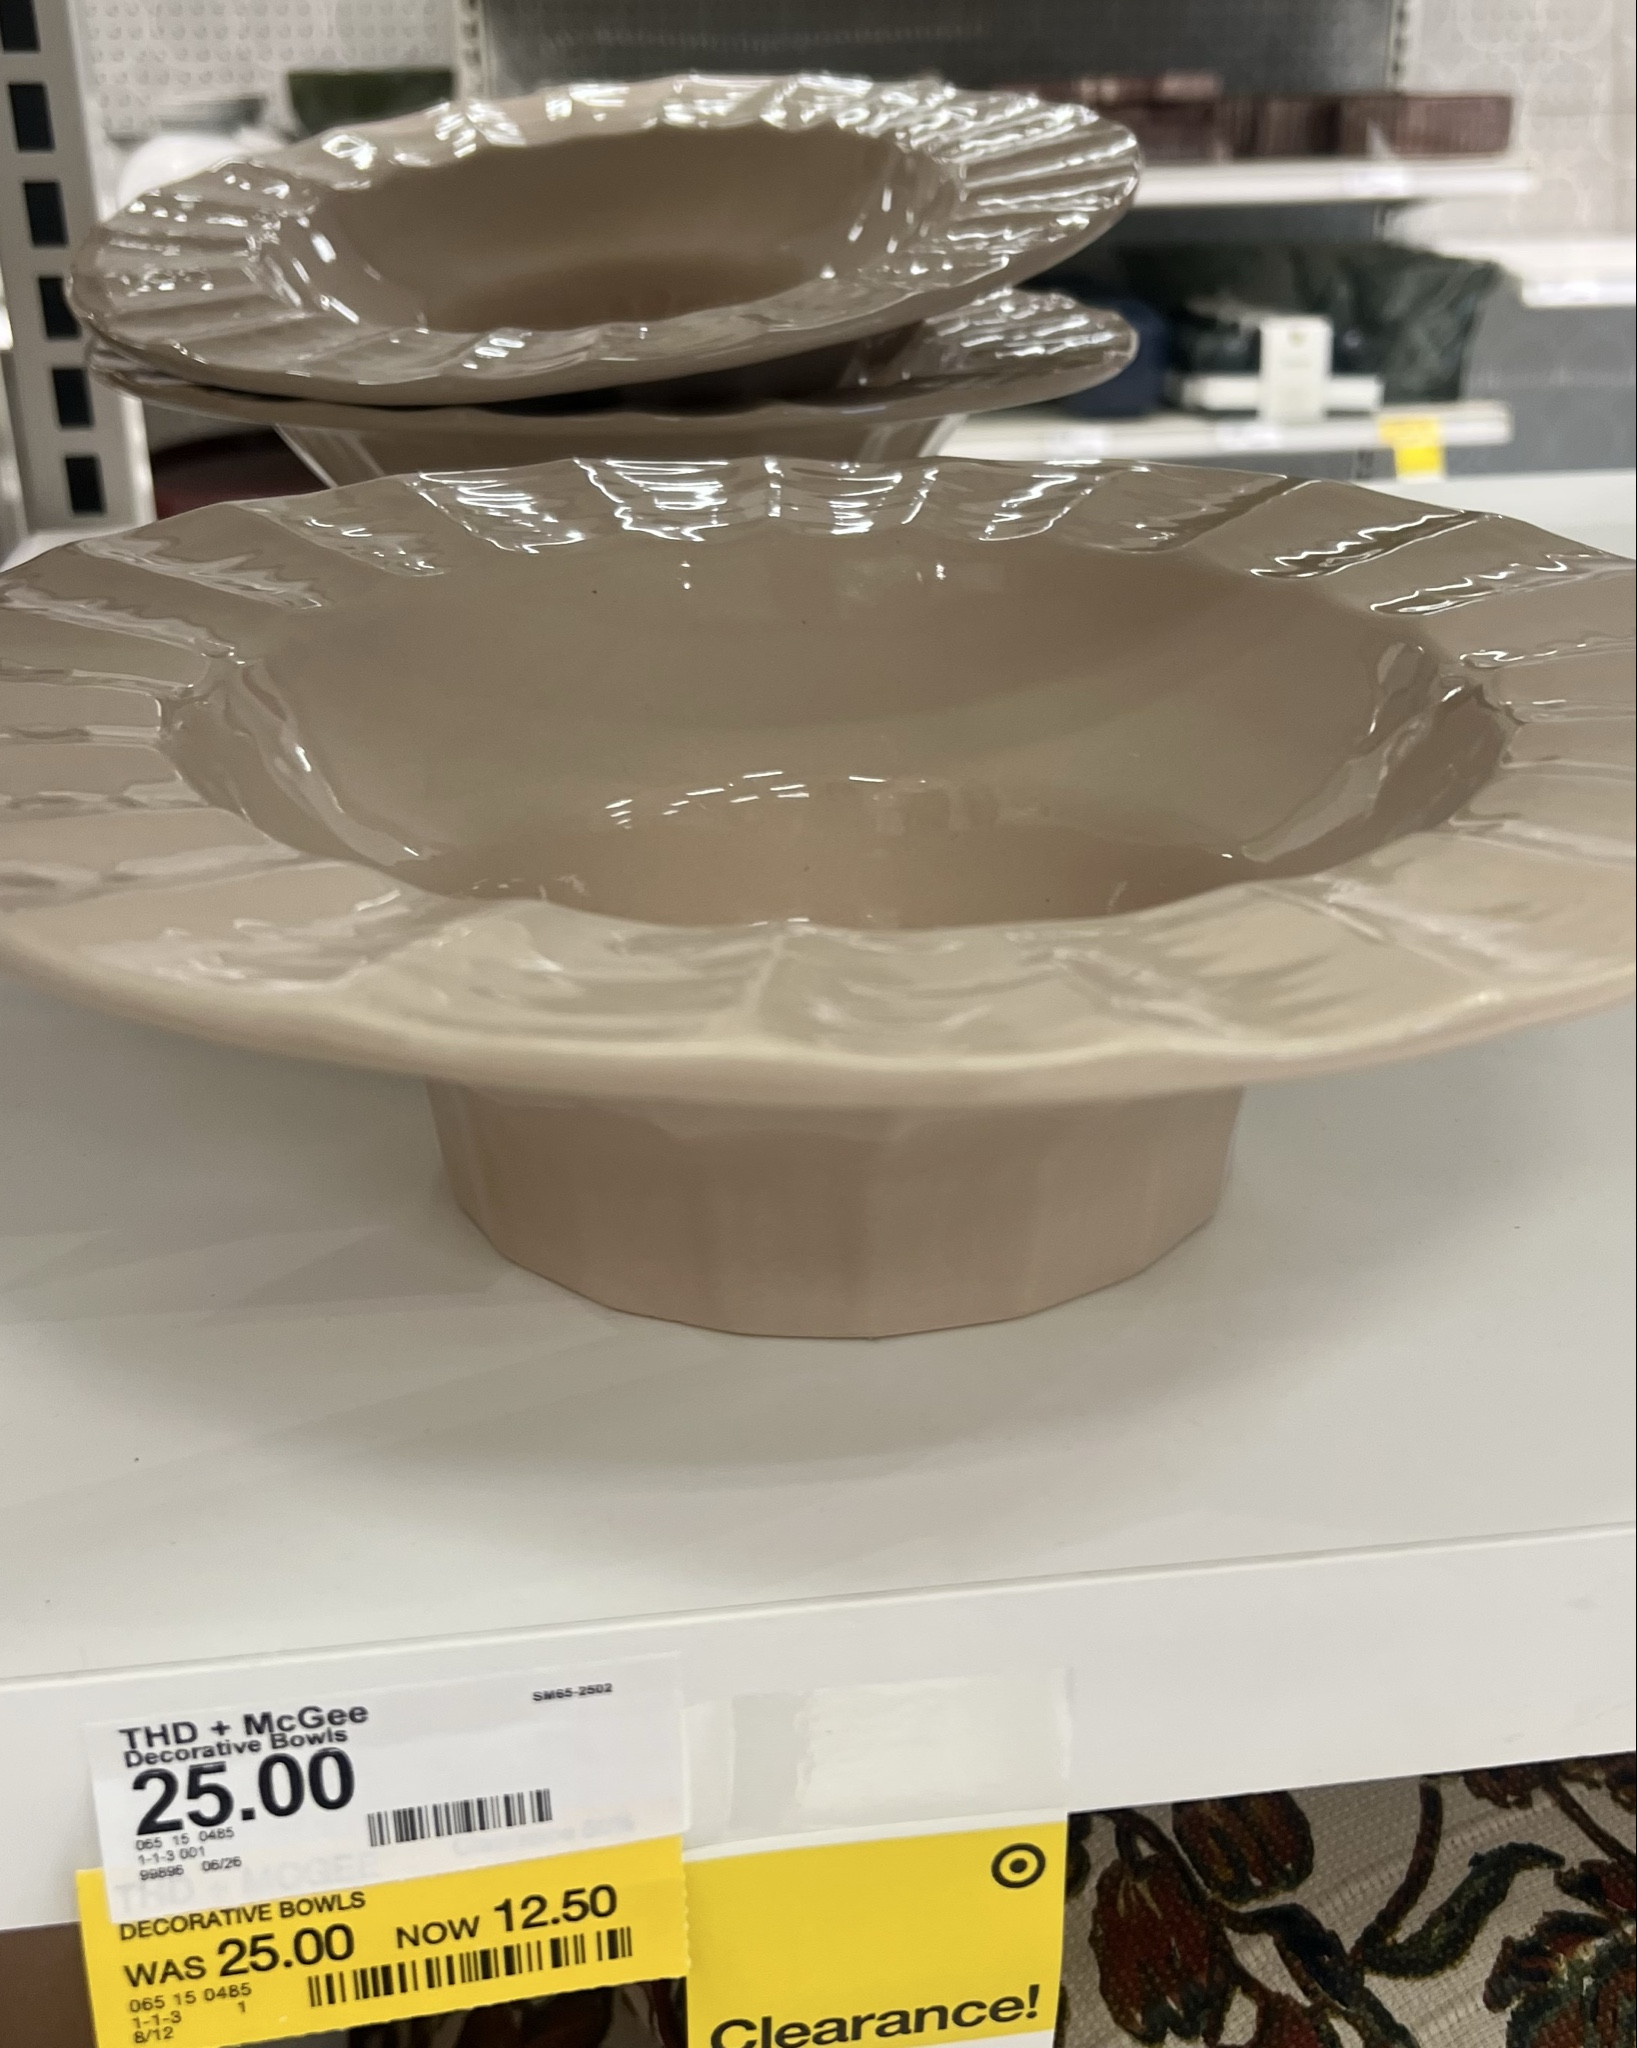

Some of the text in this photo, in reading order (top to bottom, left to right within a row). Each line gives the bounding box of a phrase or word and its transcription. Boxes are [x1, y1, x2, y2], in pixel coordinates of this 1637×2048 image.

[532, 1682, 613, 1701] SM65-2502
[119, 1705, 369, 1749] THD + McGee
[124, 1726, 349, 1768] Decorative Bowls
[132, 1746, 355, 1836] 25.00
[136, 1827, 235, 1851] 065 15 0485
[138, 1846, 205, 1865] 1-1-3 001
[201, 1857, 242, 1872] 06/26
[120, 1891, 366, 1940] DECORATIVE BOWLS
[124, 1884, 617, 1987] WAS 25.00 NOW 12.50
[129, 1982, 252, 2013] 065 15 0485
[133, 2001, 246, 2028] 1-1-3 1
[711, 1984, 1040, 2048] Clearance!
[134, 2026, 174, 2044] 8/12
